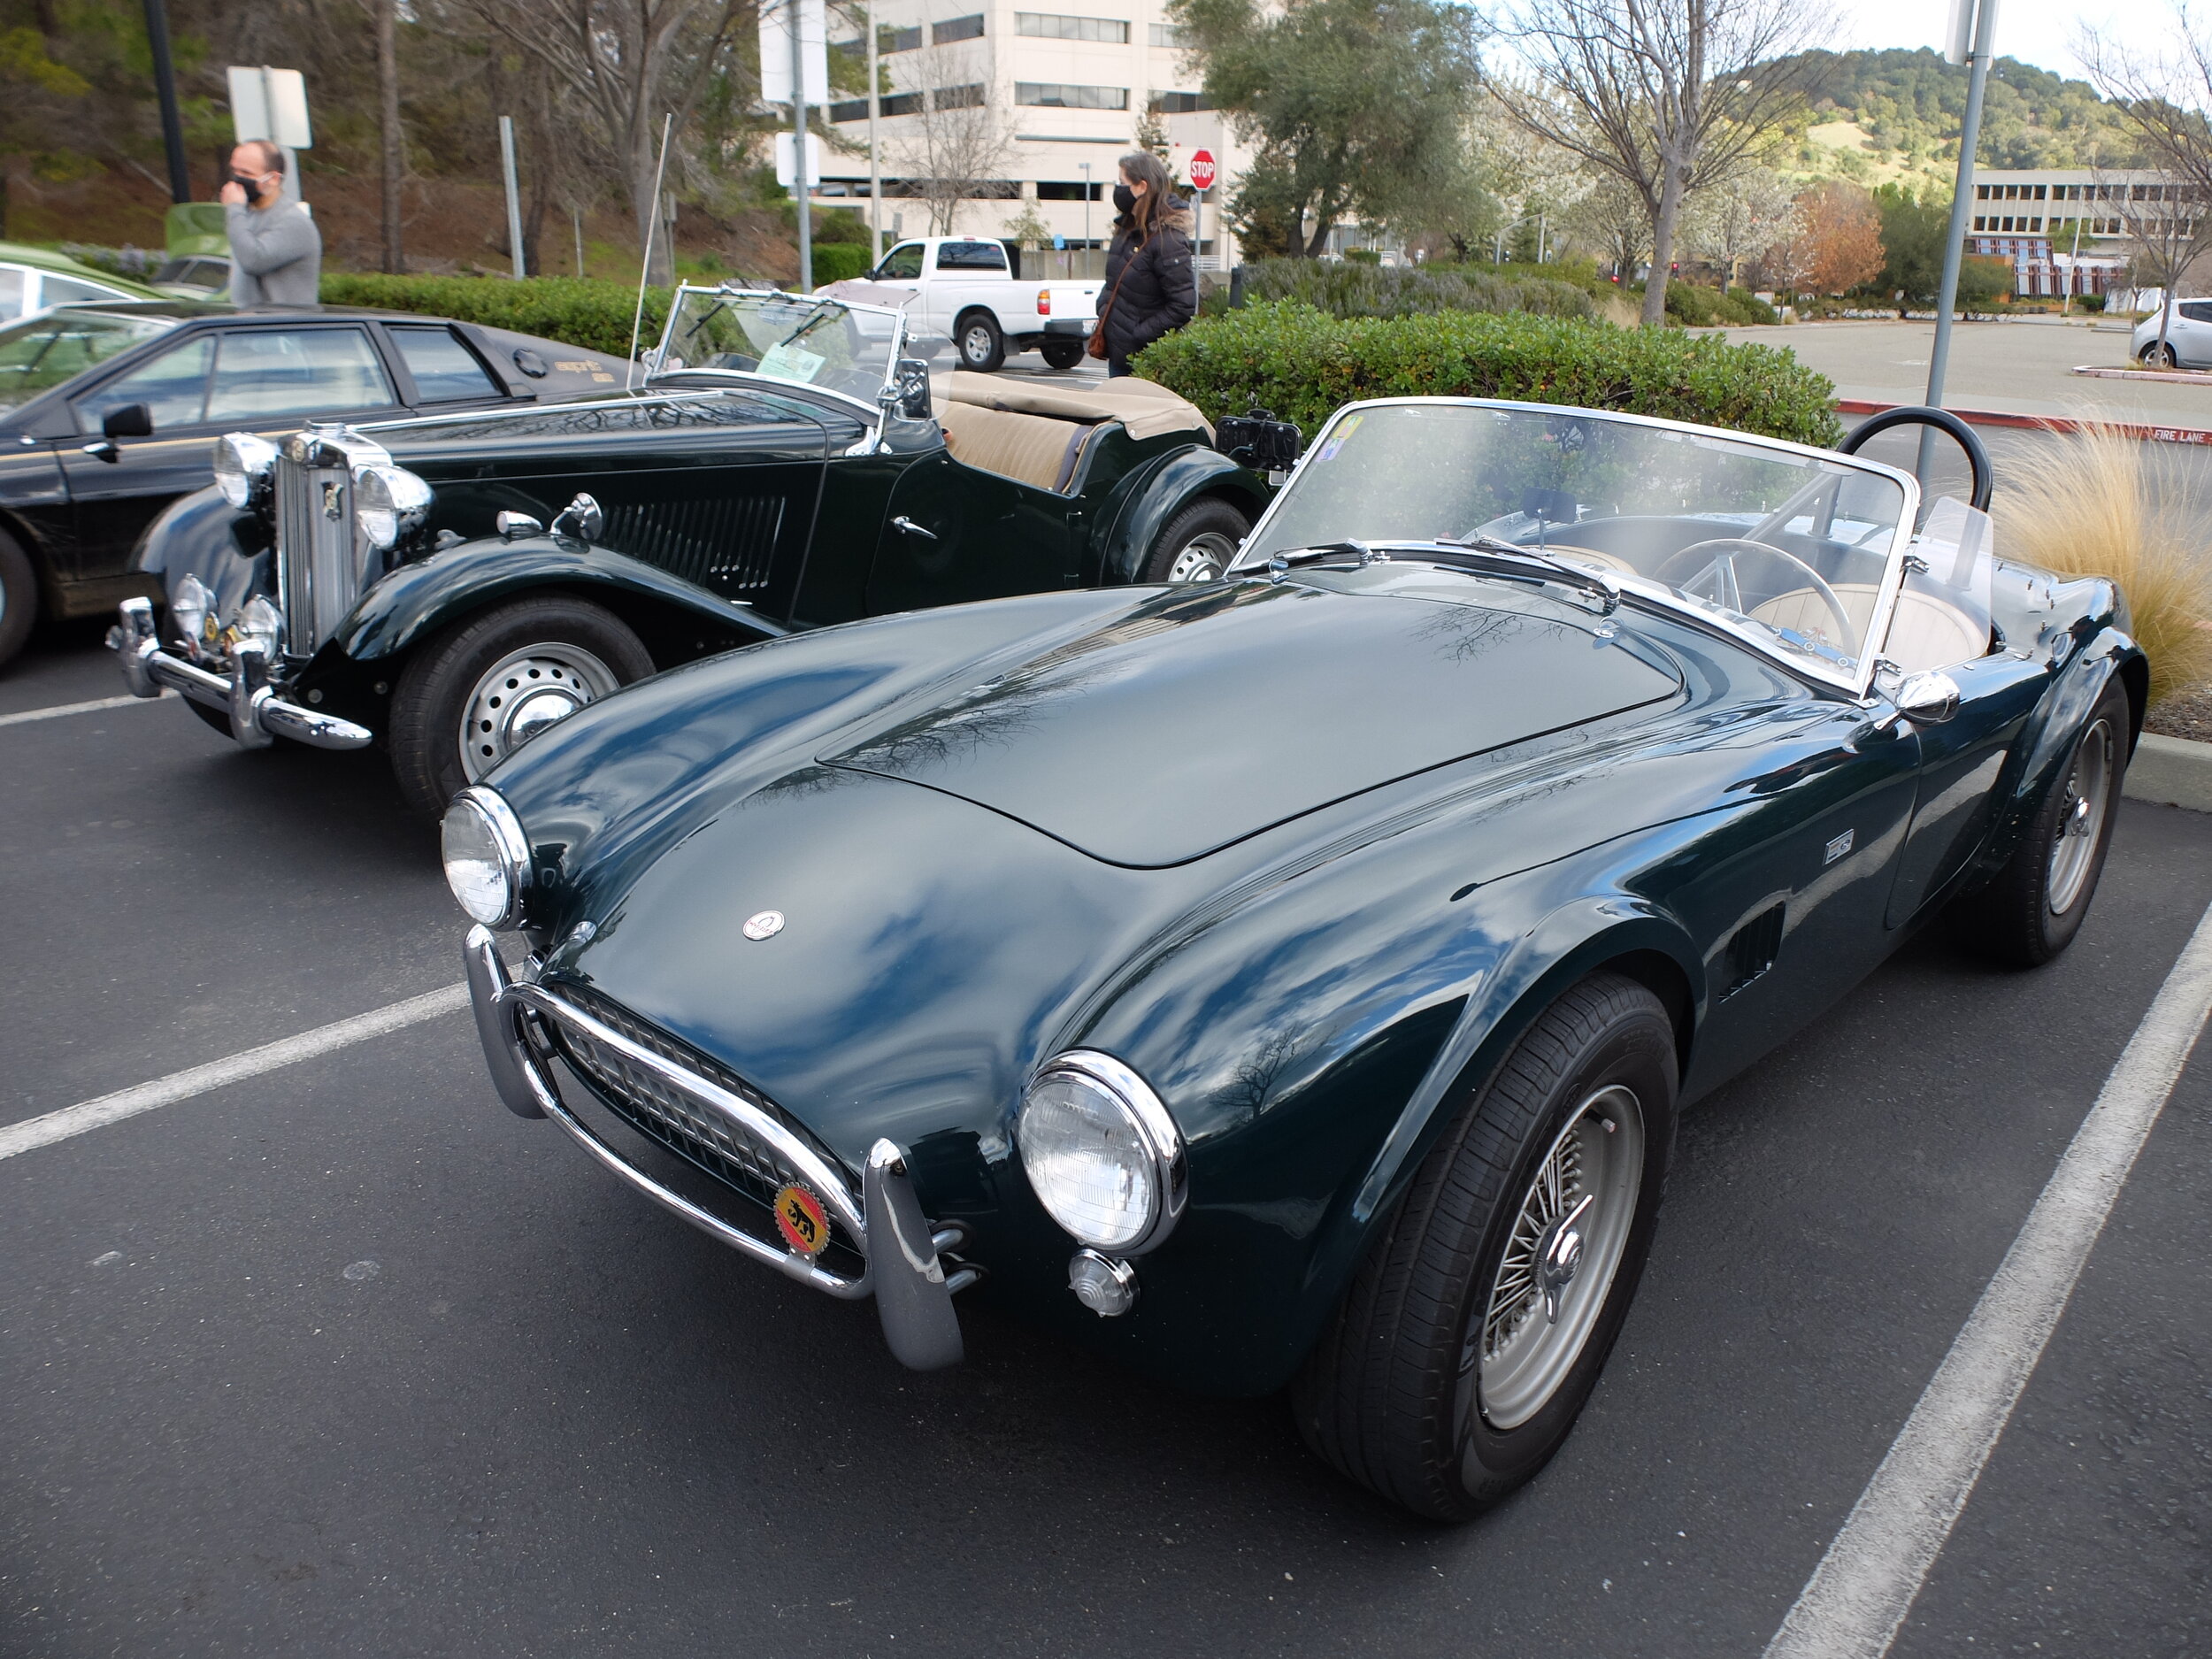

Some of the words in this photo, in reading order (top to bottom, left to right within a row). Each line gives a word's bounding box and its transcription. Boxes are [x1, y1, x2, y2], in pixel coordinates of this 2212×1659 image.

[1191, 160, 1214, 178] STOP
[2154, 429, 2176, 441] FIRE
[2179, 431, 2206, 442] LANE
